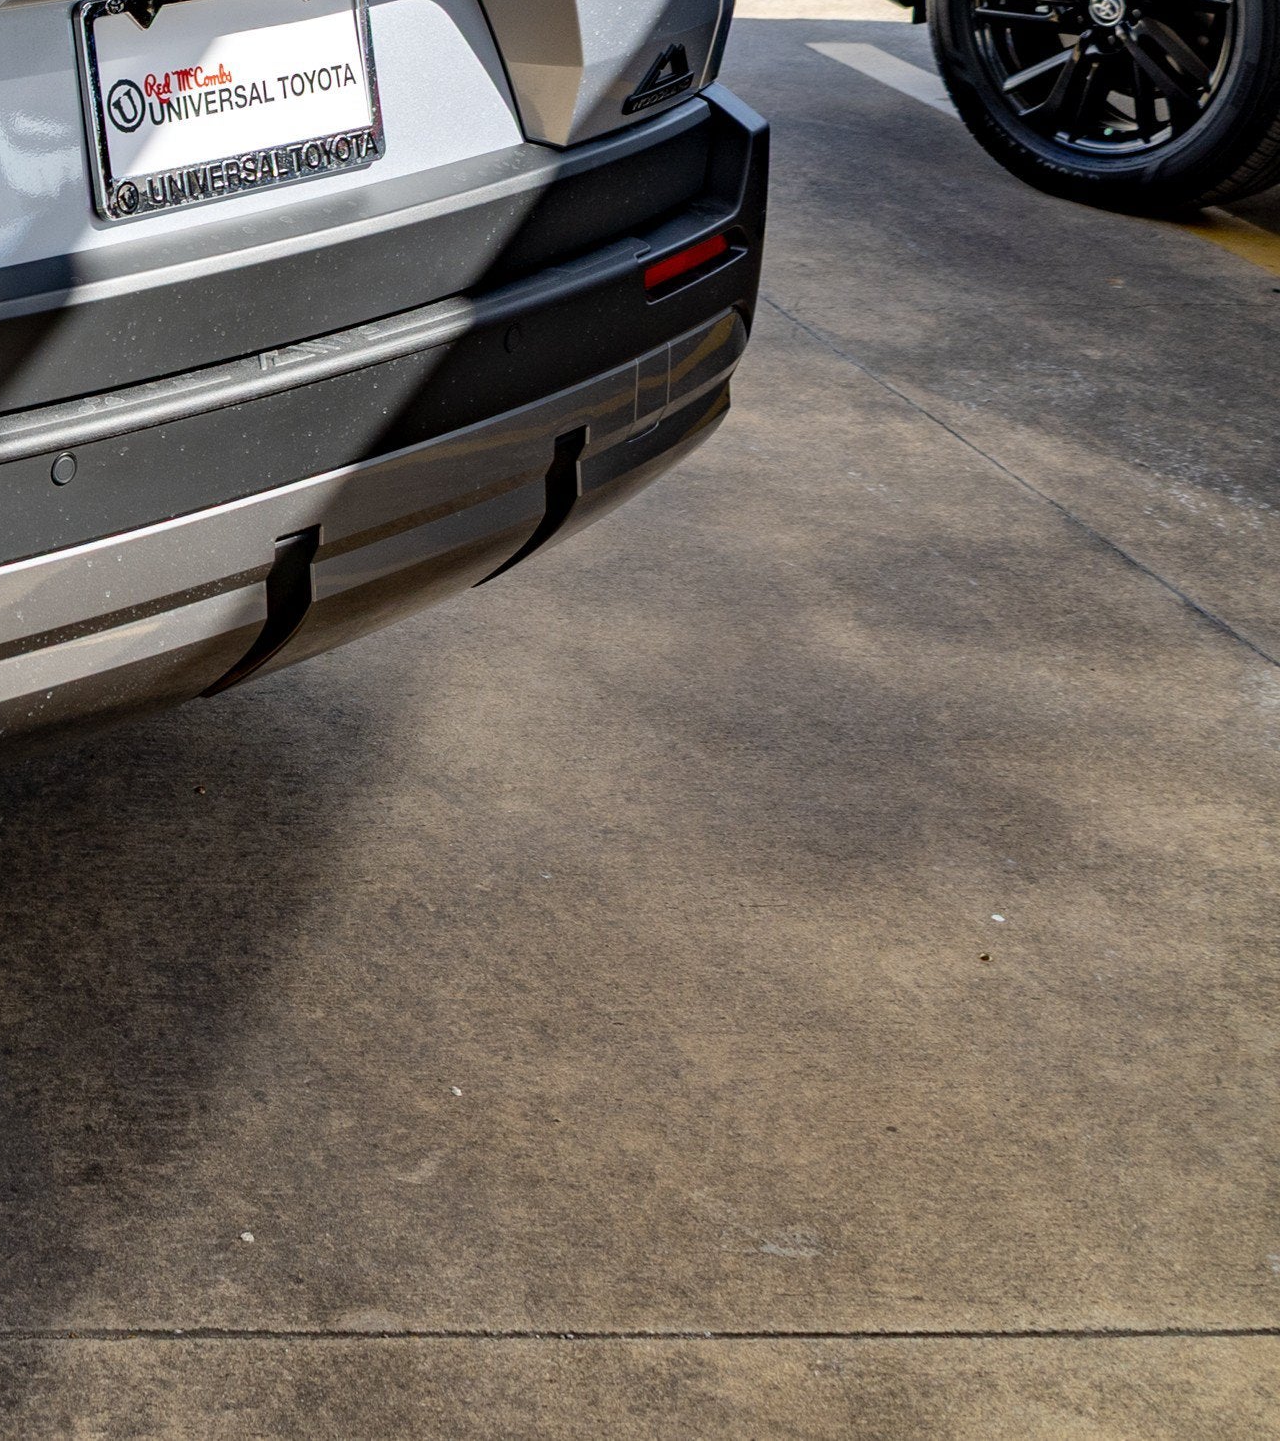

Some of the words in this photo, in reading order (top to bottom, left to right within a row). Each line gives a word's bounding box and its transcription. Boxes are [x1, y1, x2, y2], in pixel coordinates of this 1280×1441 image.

[144, 72, 173, 100] Red
[146, 85, 276, 126] UNIVERSAL
[277, 62, 357, 100] TOYOTA
[146, 151, 288, 203] UNIVERSAL
[289, 130, 380, 172] TOYOTA
